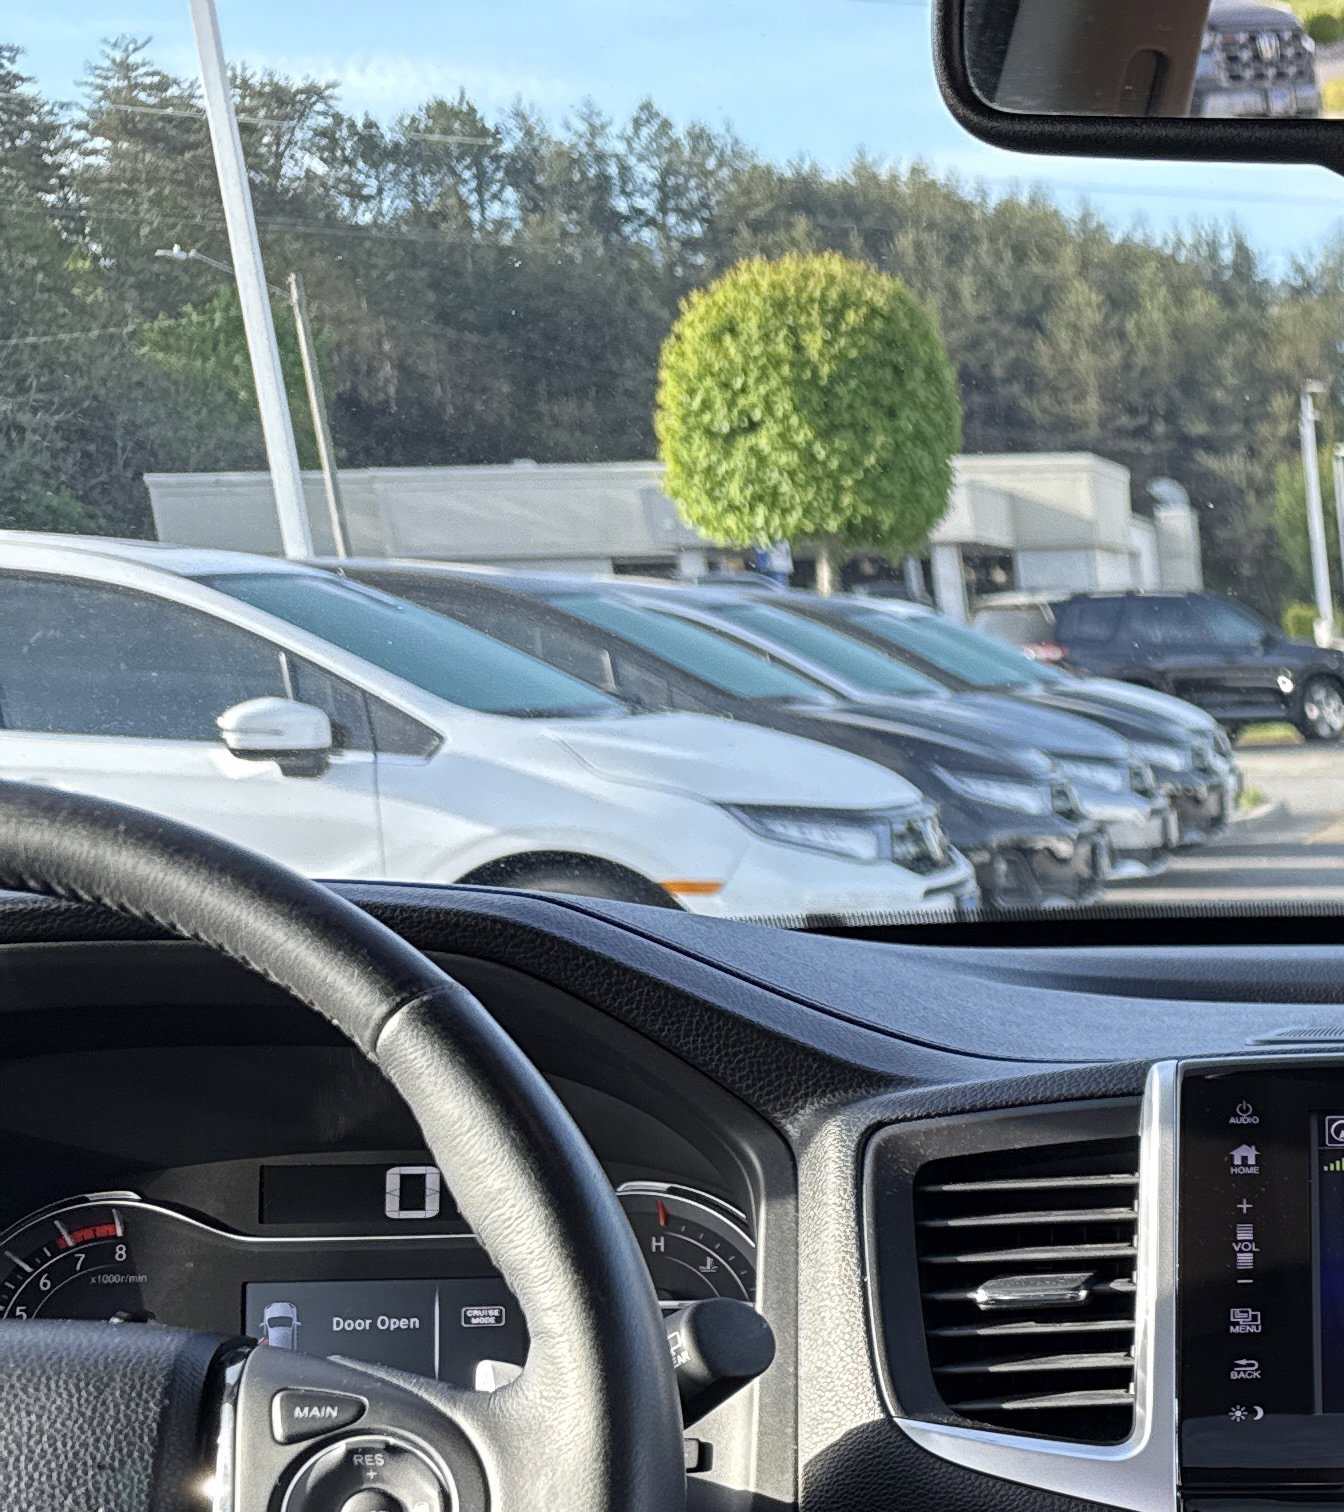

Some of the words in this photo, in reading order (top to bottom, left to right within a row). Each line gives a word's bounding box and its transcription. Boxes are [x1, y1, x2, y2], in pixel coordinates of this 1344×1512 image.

[1229, 1116, 1260, 1124] AUDIO
[1230, 1166, 1260, 1175] HOME
[385, 1166, 440, 1219] 0
[651, 1236, 665, 1252] H
[1232, 1242, 1260, 1251] VOL
[114, 1244, 127, 1261] 8
[74, 1253, 86, 1271] 7
[39, 1273, 51, 1291] 6
[15, 1306, 28, 1320] 5
[332, 1317, 372, 1331] Door
[376, 1315, 420, 1331] Open
[471, 1316, 496, 1324] MODE
[1229, 1325, 1262, 1334] MENU
[1230, 1370, 1261, 1380] BACK
[293, 1406, 338, 1419] MAIN
[353, 1453, 385, 1466] RES
